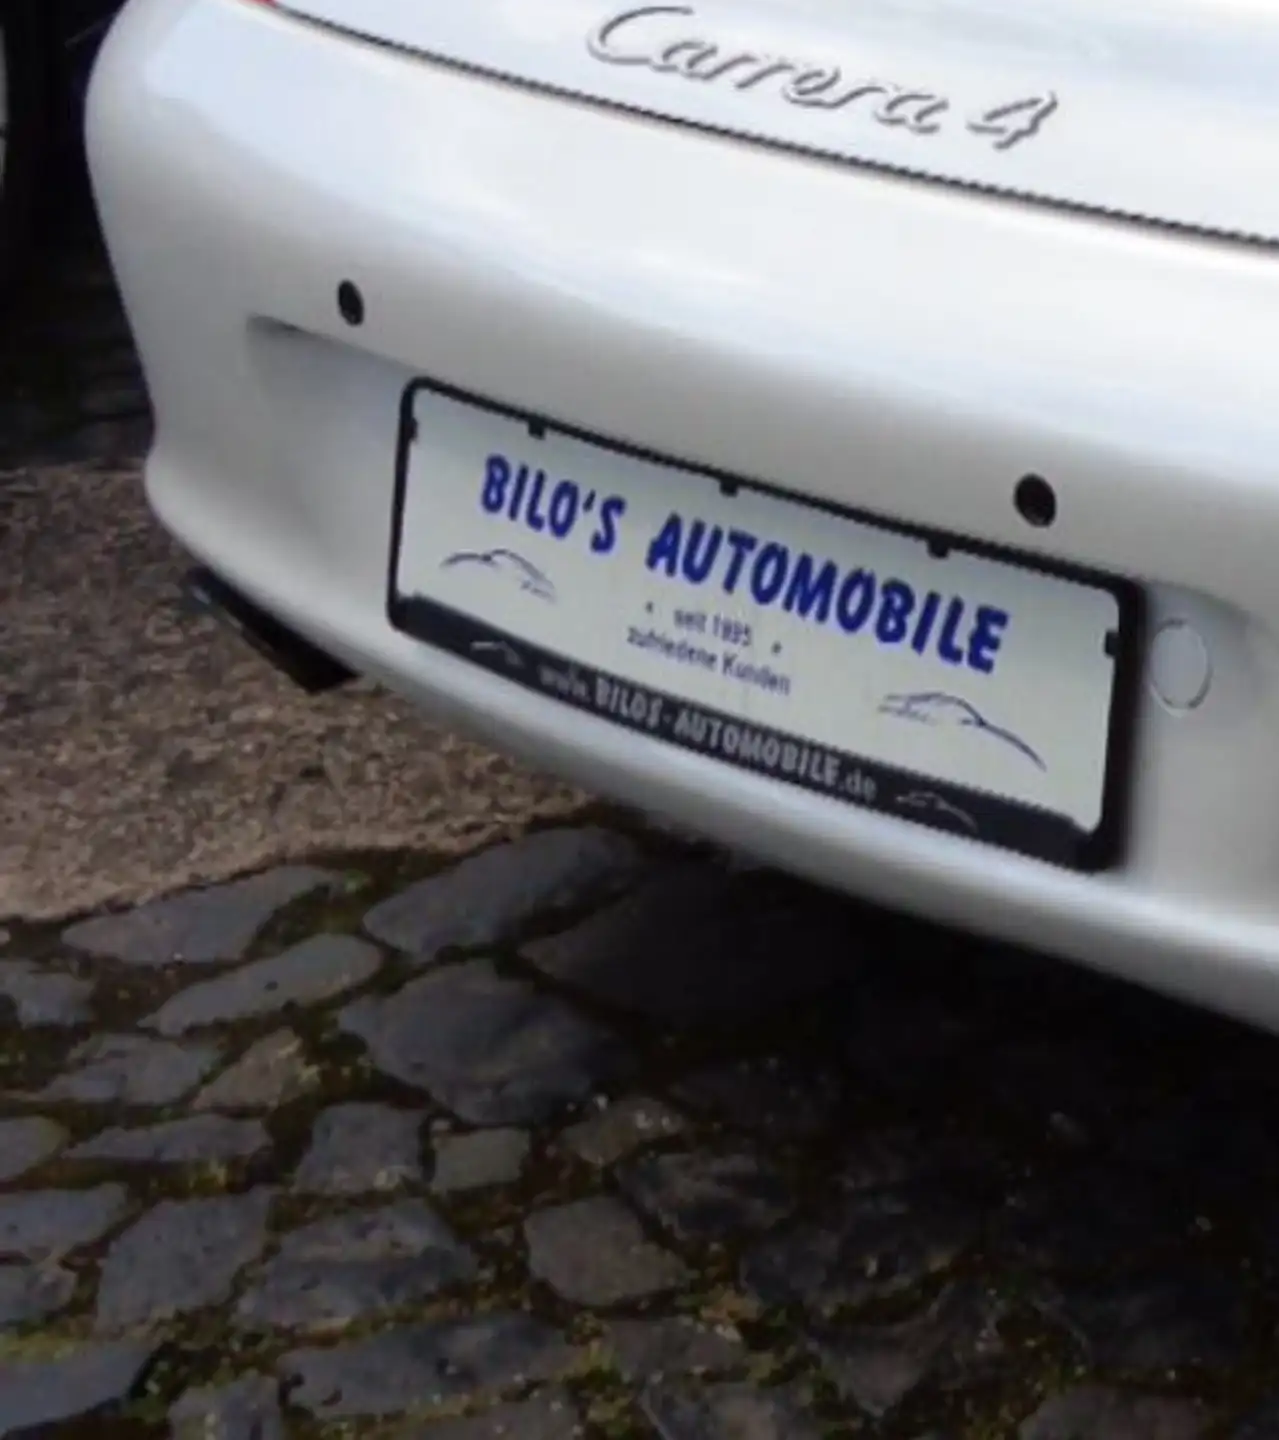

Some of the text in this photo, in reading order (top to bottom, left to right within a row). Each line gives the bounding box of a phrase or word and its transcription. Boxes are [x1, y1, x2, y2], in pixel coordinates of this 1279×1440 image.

[587, 5, 1059, 152] Carrera 4
[480, 454, 1011, 675] BILO'S AUTOMOBILE
[721, 651, 792, 697] Kunden
